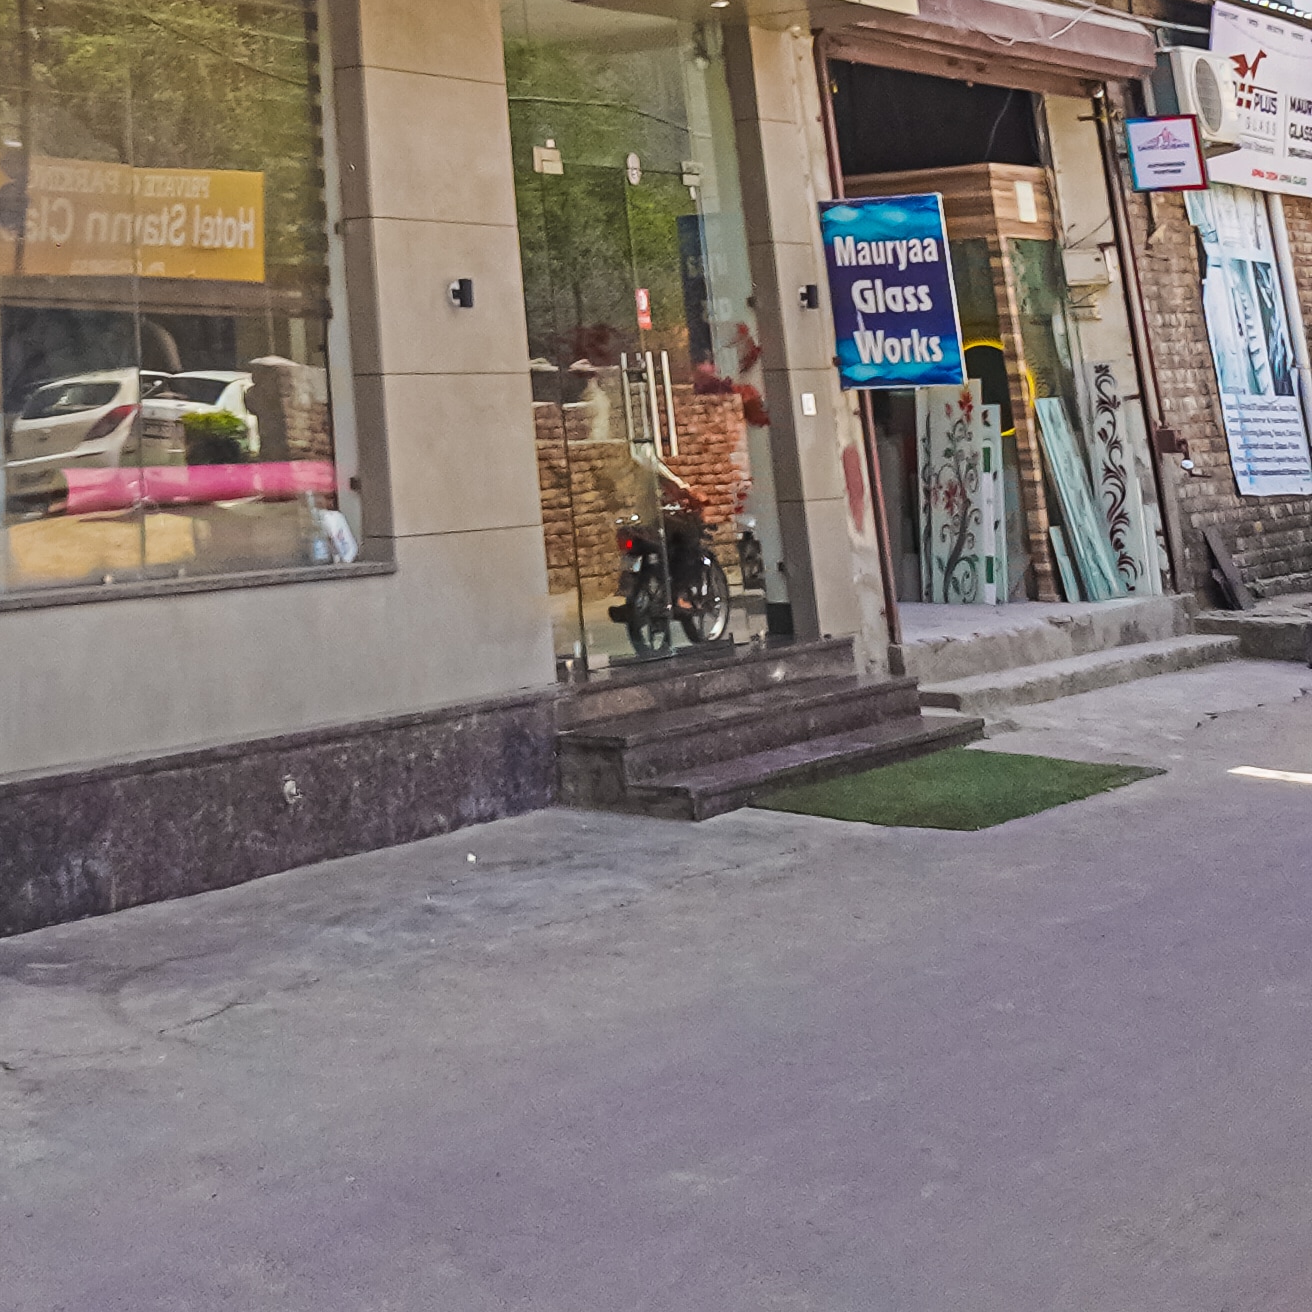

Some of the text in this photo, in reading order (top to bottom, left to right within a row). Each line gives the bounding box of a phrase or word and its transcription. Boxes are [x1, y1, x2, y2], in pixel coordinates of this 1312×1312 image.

[833, 236, 939, 271] Mauryaa
[851, 278, 933, 314] Glass
[853, 328, 943, 364] Works
